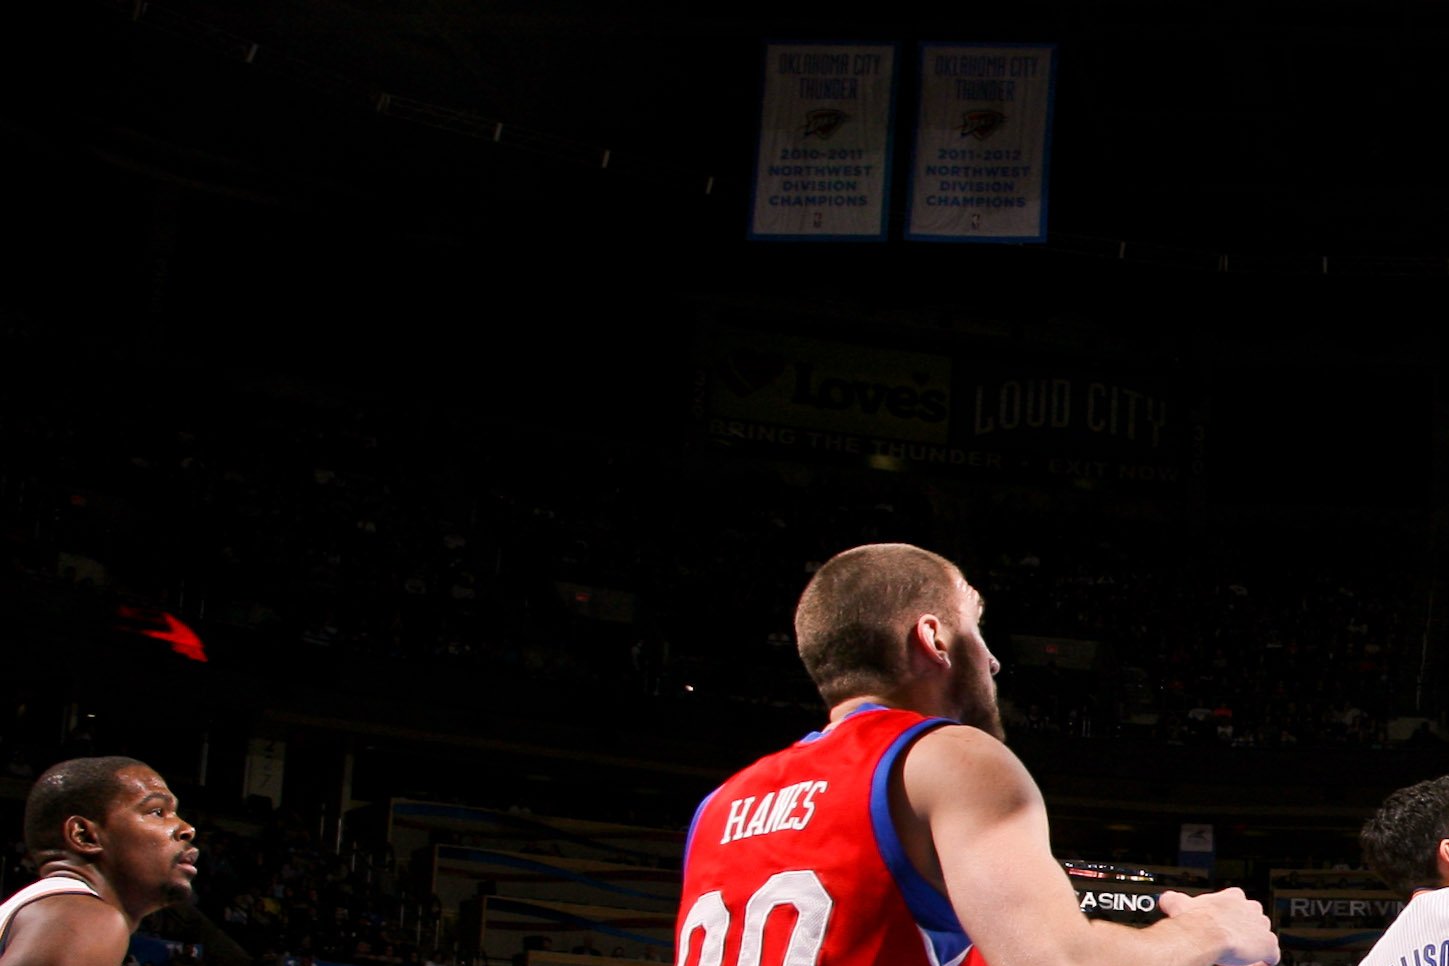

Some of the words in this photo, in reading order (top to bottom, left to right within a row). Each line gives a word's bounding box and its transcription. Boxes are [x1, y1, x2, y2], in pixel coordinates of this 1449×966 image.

[779, 53, 848, 76] OKLAHOMA
[854, 54, 881, 75] CITY
[935, 55, 1005, 78] OKLAHOMA
[1009, 56, 1039, 78] CITY
[800, 78, 857, 100] THUNDER
[956, 79, 1014, 101] THUNDER
[780, 149, 863, 161] 2010-2011
[938, 150, 1021, 161] 2011-2012
[768, 165, 872, 177] NORTHWEST
[926, 165, 1030, 178] NORTHWEST
[783, 180, 856, 191] DIVISION
[940, 181, 1014, 193] DIVISION
[769, 195, 868, 207] CHAMPIONS
[926, 196, 1026, 208] CHAMPIONS
[974, 378, 1071, 437] LOUD
[1087, 382, 1168, 448] CITY
[1074, 890, 1155, 912] ASINO
